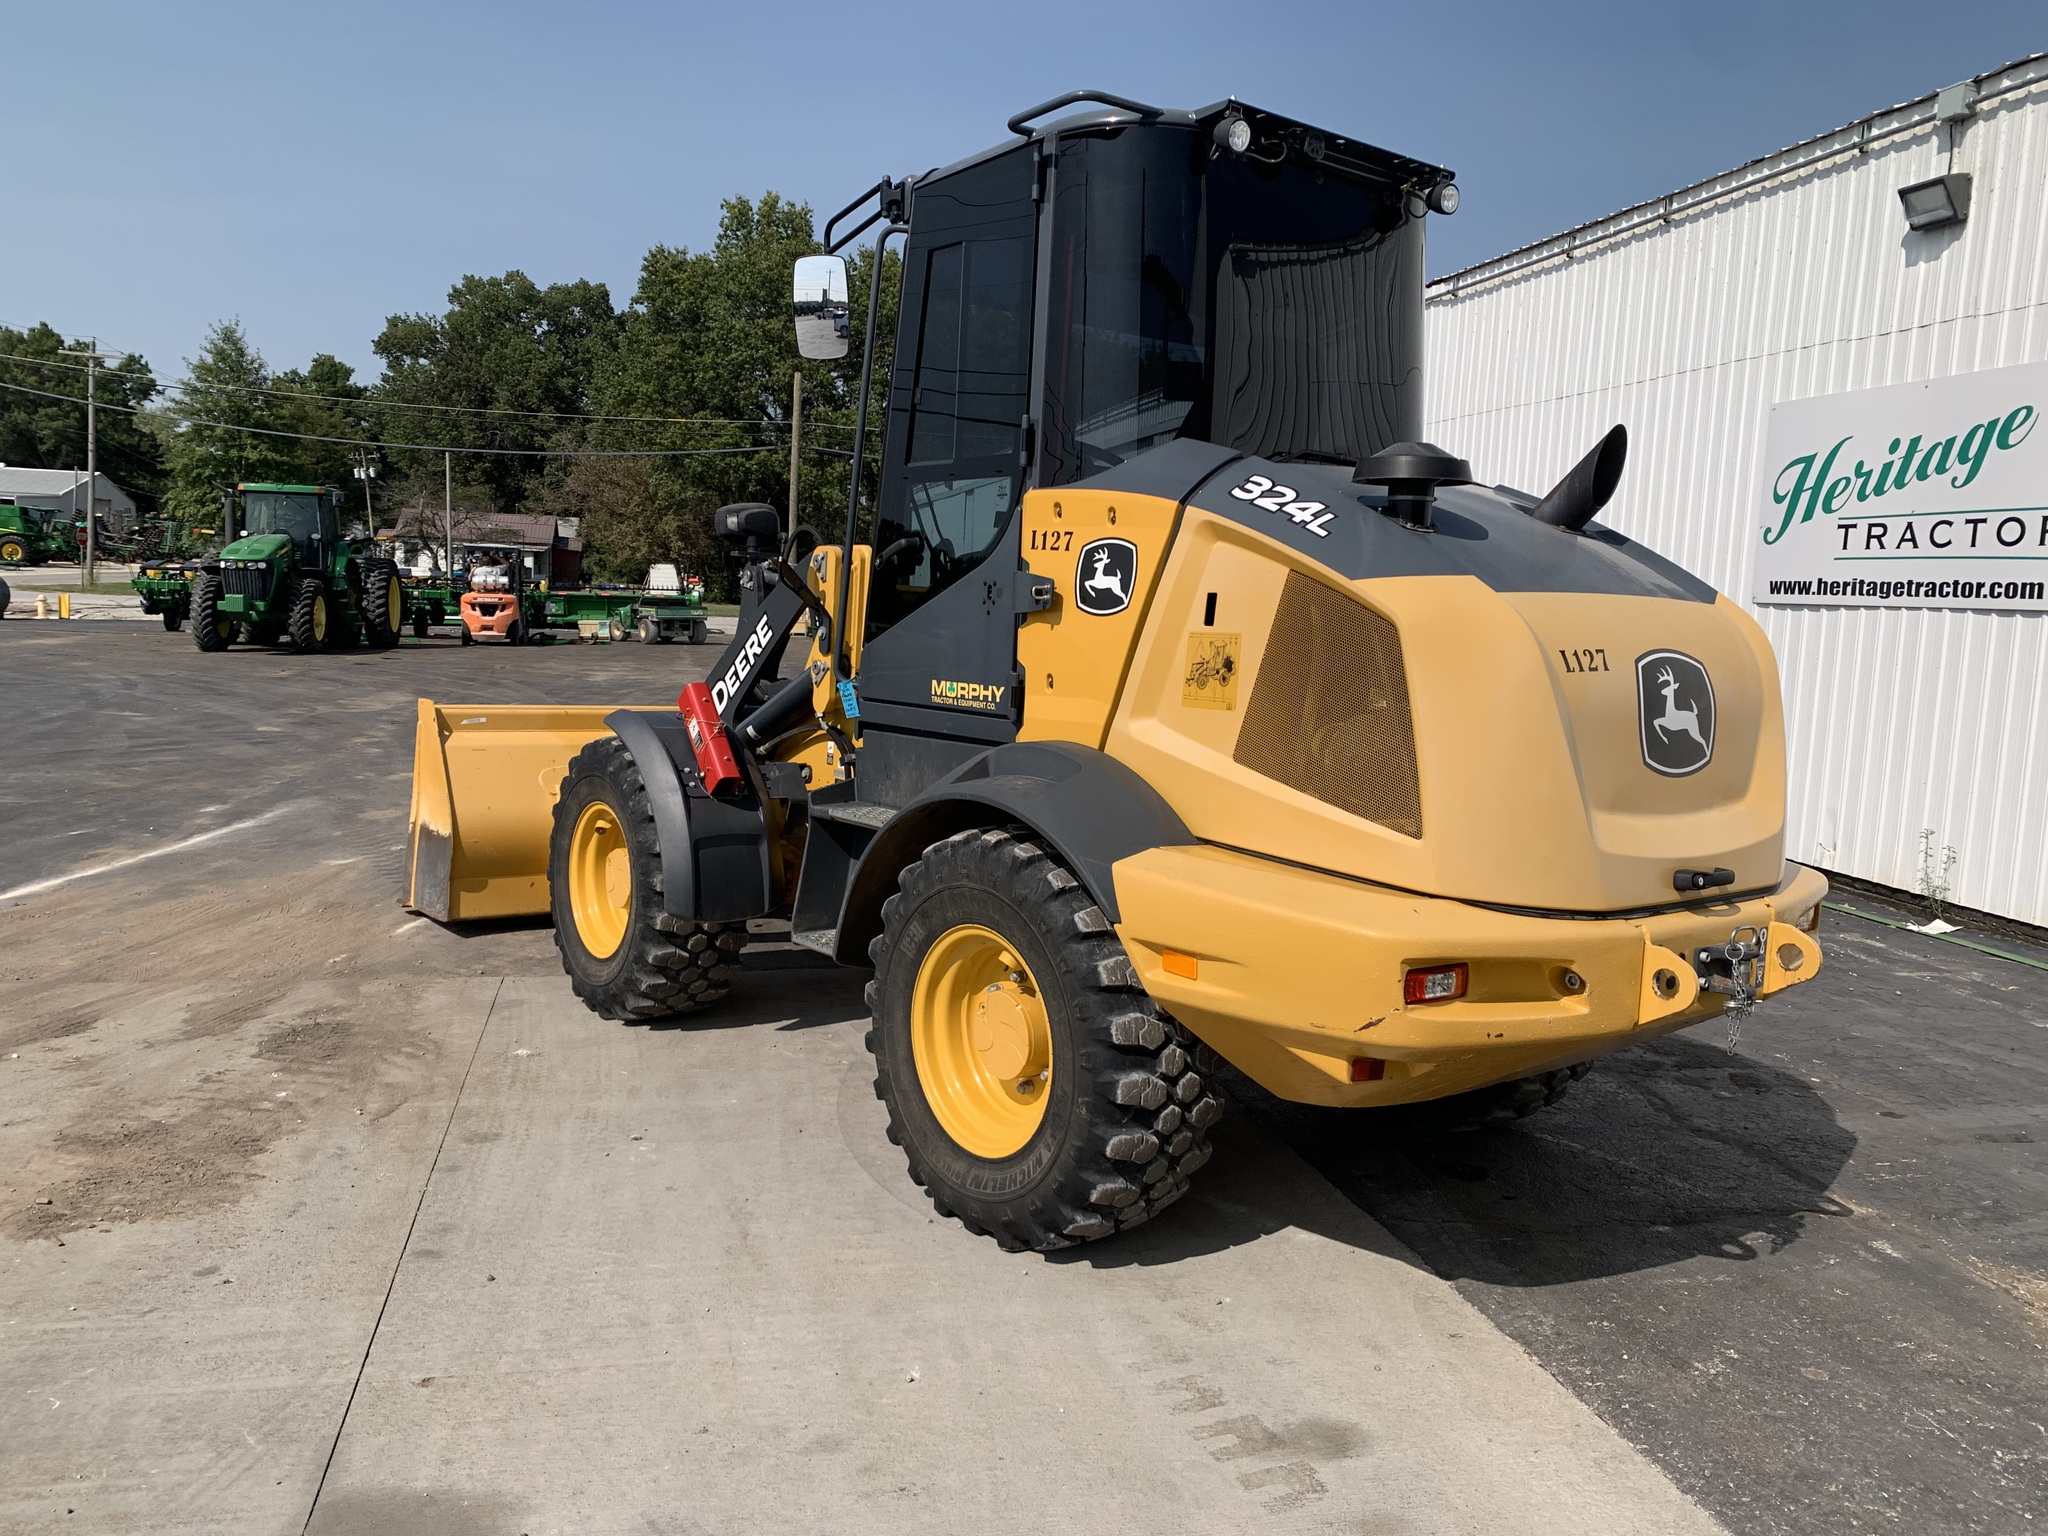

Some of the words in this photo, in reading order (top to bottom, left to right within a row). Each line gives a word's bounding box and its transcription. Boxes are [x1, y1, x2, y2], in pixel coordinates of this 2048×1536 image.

[1763, 404, 2040, 545] Heritage
[1229, 474, 1338, 538] 324L
[1030, 529, 1075, 551] L127
[1769, 578, 2045, 600] www.heritagetractor.com
[711, 613, 773, 716] DEERE
[1558, 648, 1610, 673] L127
[931, 679, 1005, 702] MURPHY
[931, 696, 953, 705] TRACTOR
[958, 699, 986, 709] EQUIPMENT
[966, 1151, 1044, 1193] MICHELIN
